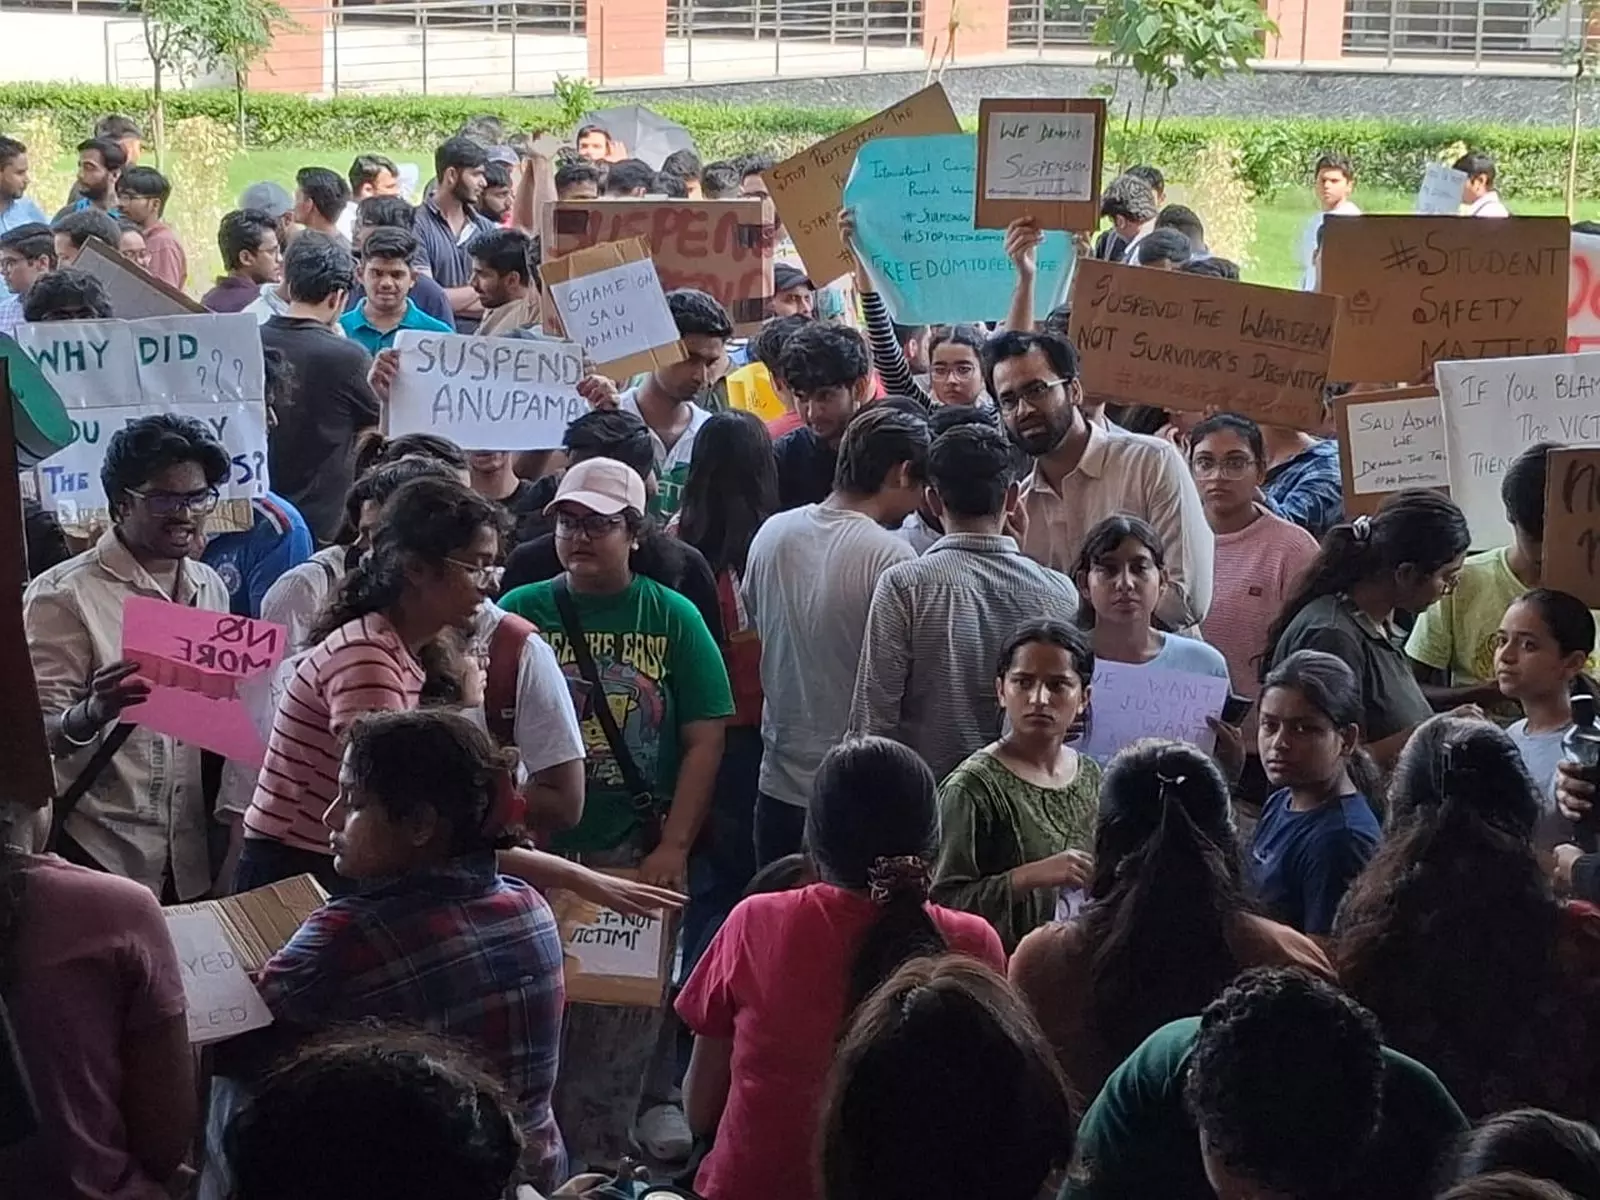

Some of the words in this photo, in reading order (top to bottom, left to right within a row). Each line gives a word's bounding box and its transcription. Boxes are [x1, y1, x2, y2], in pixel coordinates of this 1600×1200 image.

[1380, 230, 1566, 277] #STUDENT
[567, 278, 627, 313] SHAME
[588, 304, 625, 327] SAU
[1412, 286, 1524, 329] SAFETY
[585, 321, 634, 349] ADMIN
[1191, 298, 1225, 328] THE
[1240, 305, 1331, 351] WARDEN
[27, 340, 110, 375] WHY
[138, 333, 200, 367] DID
[416, 338, 581, 386] SUSPEND
[1077, 326, 1119, 351] NOT
[1130, 332, 1239, 373] SURVIVOR'S
[1460, 375, 1489, 407] IF
[1401, 409, 1443, 432] ADMI
[1559, 413, 1600, 441] VICT
[621, 631, 668, 681] EASY
